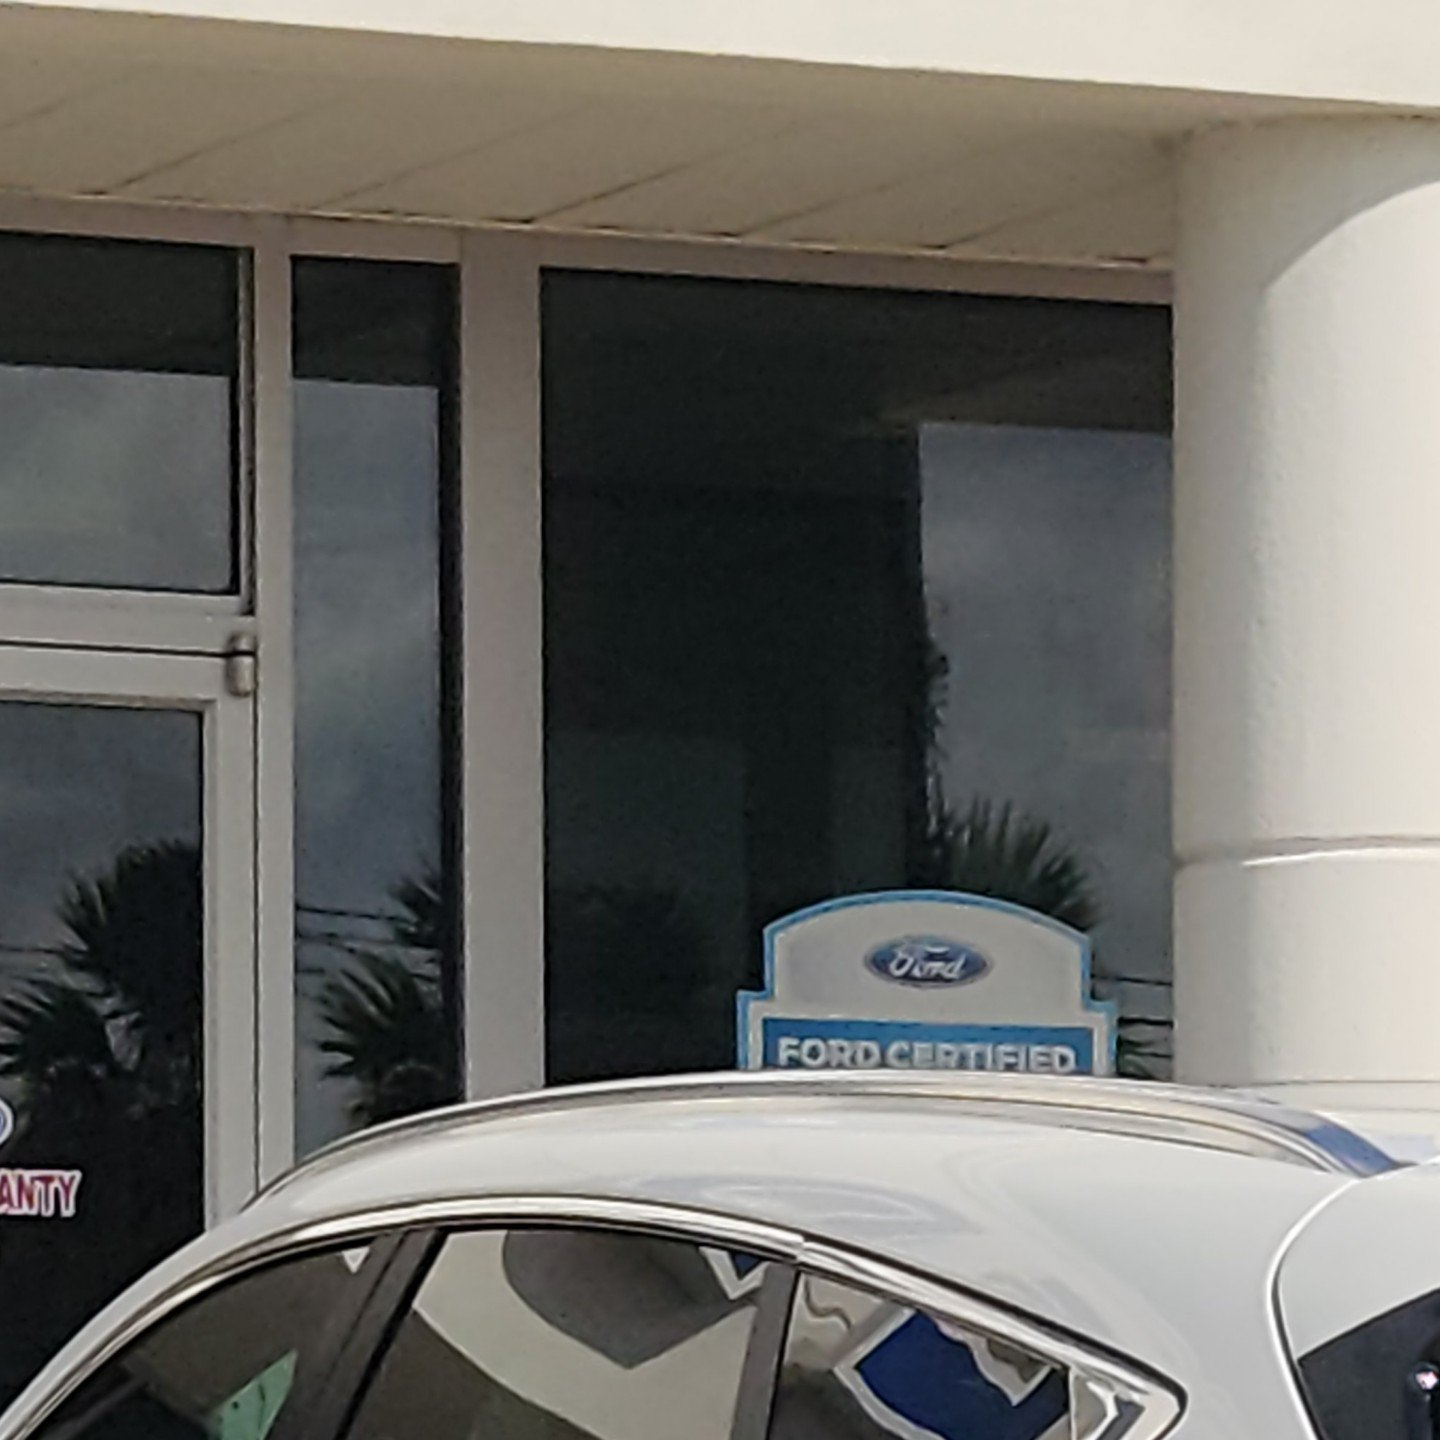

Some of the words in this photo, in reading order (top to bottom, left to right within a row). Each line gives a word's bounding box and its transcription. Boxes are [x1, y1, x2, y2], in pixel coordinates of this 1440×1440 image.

[888, 942, 967, 981] Ford
[777, 1036, 882, 1070] FORD
[884, 1040, 1077, 1074] CERTIFIED
